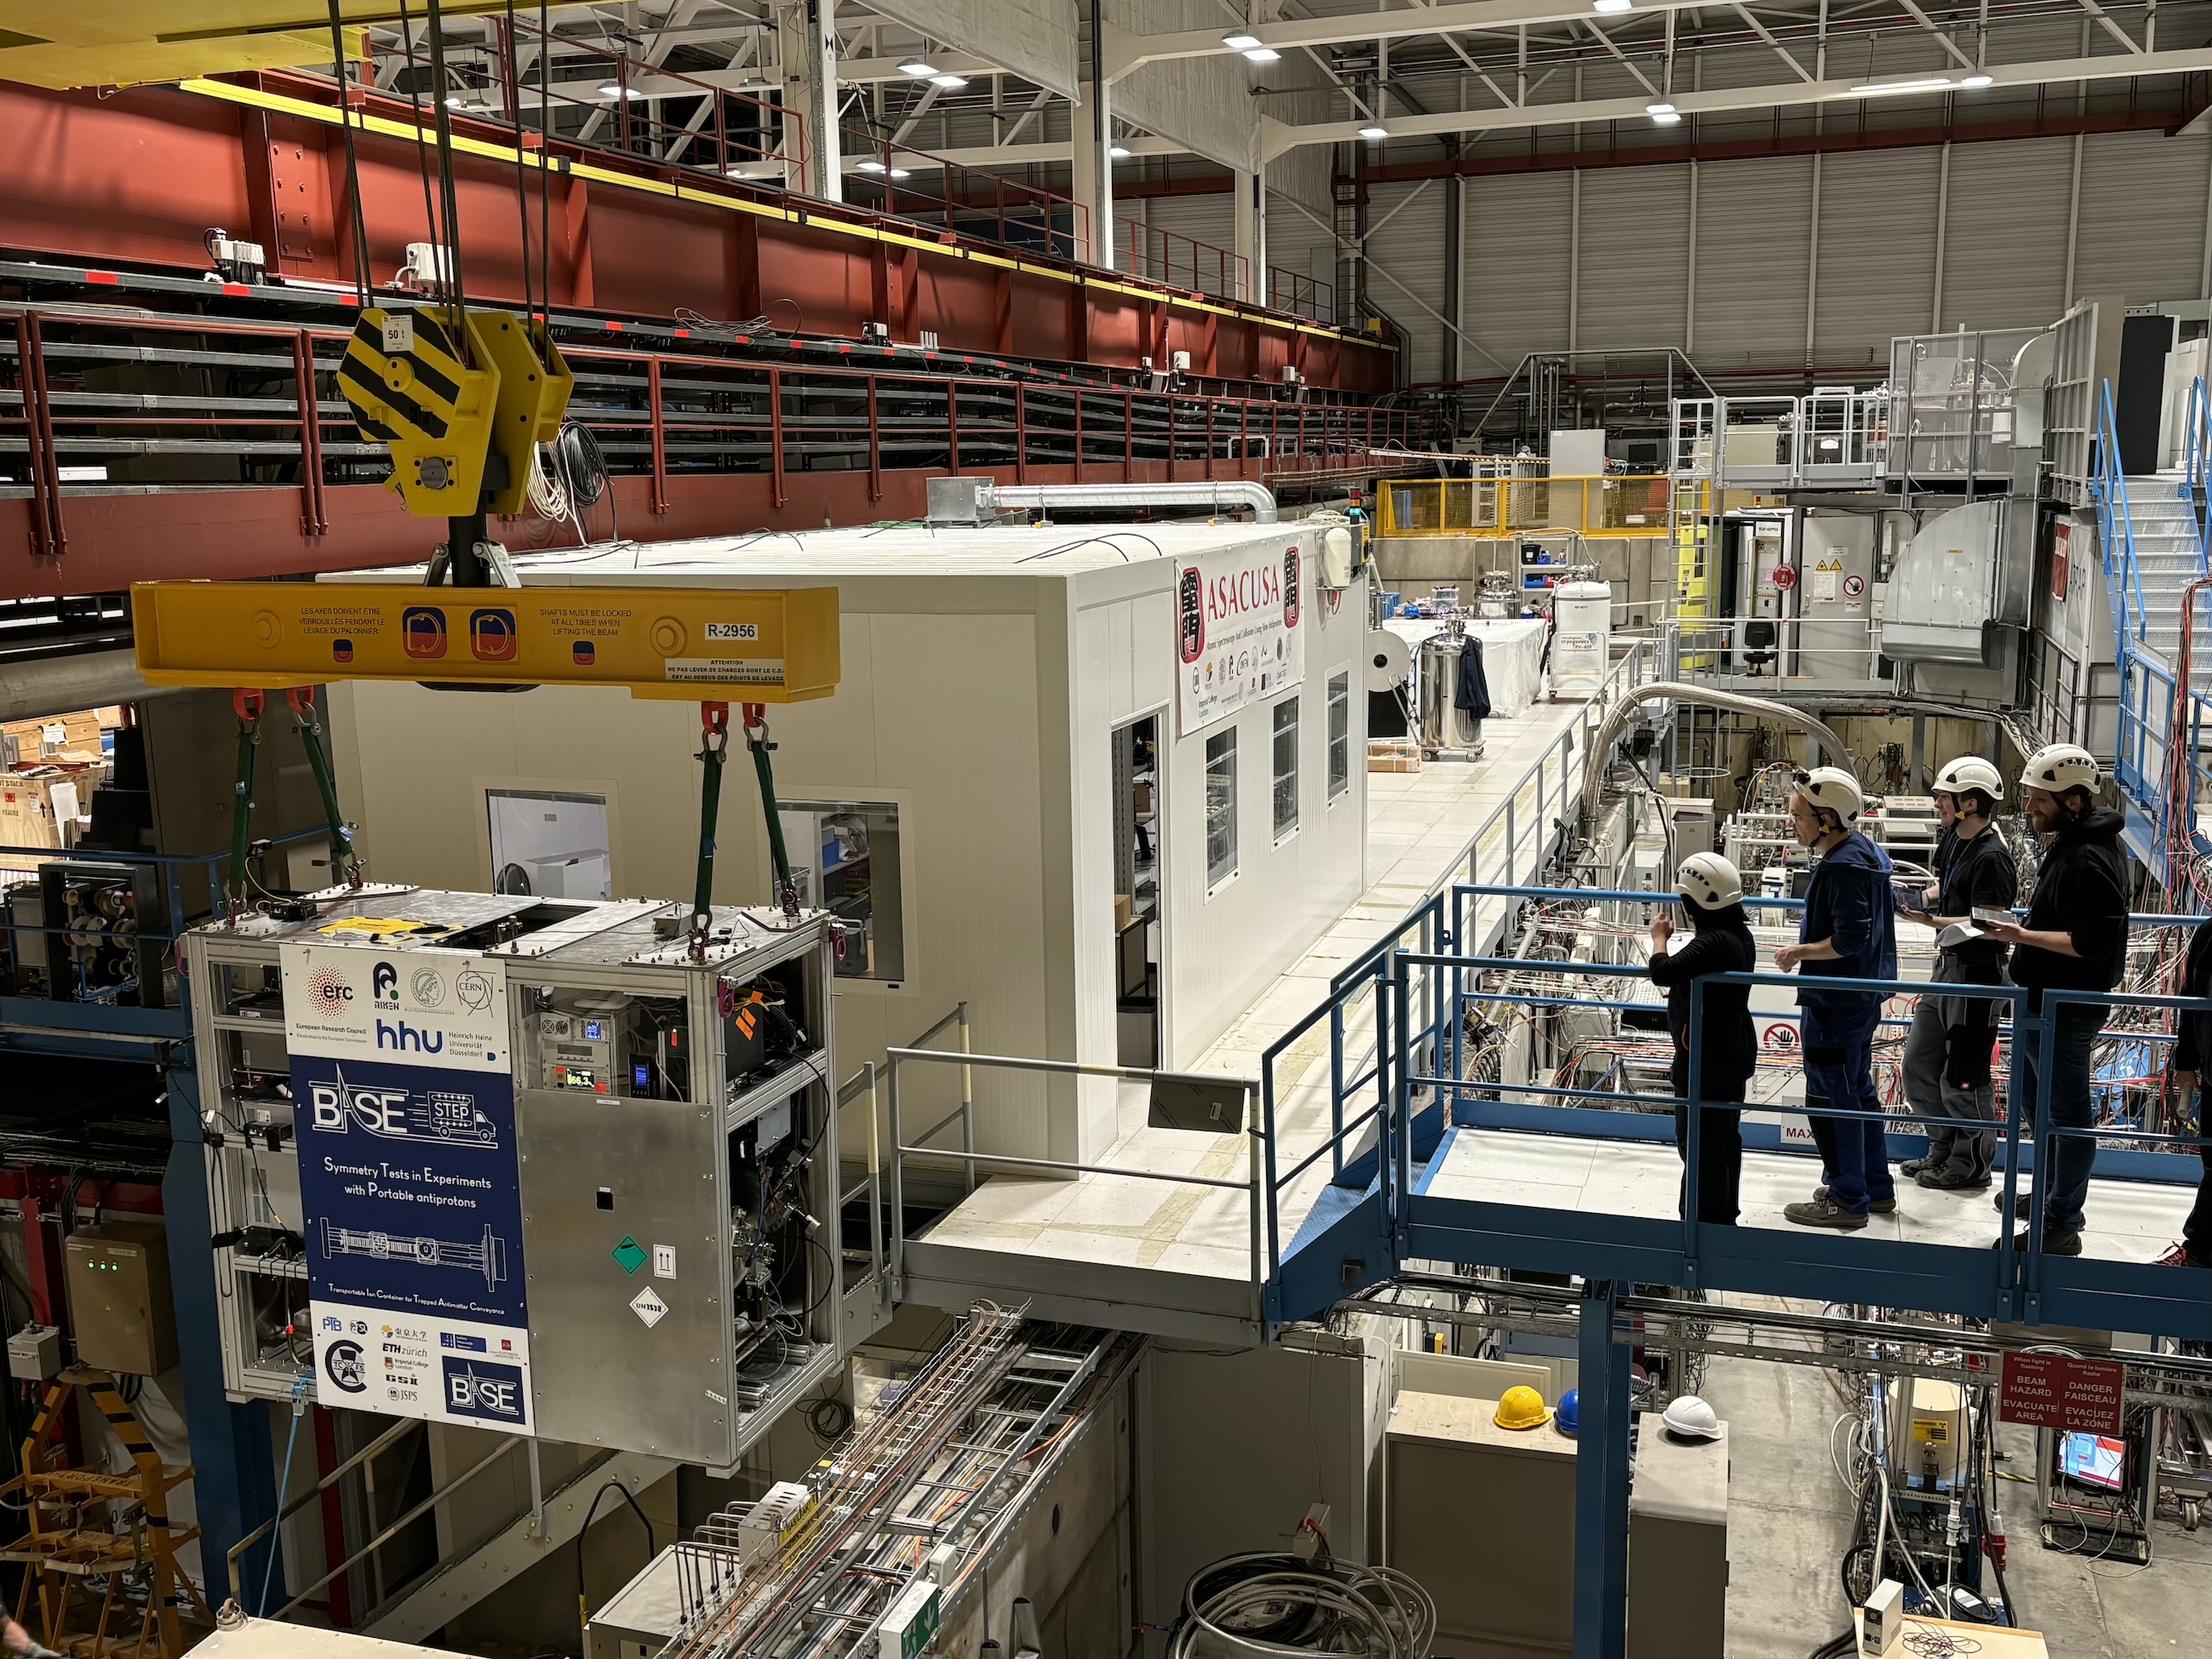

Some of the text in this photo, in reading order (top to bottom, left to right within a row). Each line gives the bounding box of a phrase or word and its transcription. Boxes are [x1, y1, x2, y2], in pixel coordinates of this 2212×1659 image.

[388, 329, 398, 340] 50
[1207, 564, 1280, 622] ASACUSA
[708, 624, 755, 638] R-2956
[1217, 634, 1235, 649] Spectroscopy
[1241, 627, 1254, 638] Collisions
[324, 985, 353, 1000] erc
[459, 982, 482, 992] CERN
[375, 1001, 399, 1010] RIKEN
[376, 1019, 443, 1054] hhu
[449, 1032, 473, 1040] Heinrich
[450, 1040, 482, 1049] Universität
[450, 1049, 483, 1058] Düsseldorf
[310, 1077, 410, 1135] BASE
[324, 1157, 492, 1189] Symmetry Tests in Experiments
[345, 1181, 477, 1209] with Portable antiprotons
[329, 1283, 365, 1297] Transportable
[366, 1288, 375, 1297] Ion
[376, 1290, 404, 1301] Container
[413, 1294, 437, 1307] Trapped
[438, 1298, 468, 1310] Antimatter
[470, 1302, 505, 1315] Conveyance
[323, 1317, 342, 1332] PTB
[382, 1342, 427, 1358] ETH zürich
[413, 1360, 428, 1369] College
[2020, 1364, 2044, 1372] flashing
[2031, 1358, 2045, 1366] light
[2016, 1376, 2047, 1386] BEAM
[450, 1370, 517, 1411] BASE
[2010, 1385, 2052, 1398] HAZARD
[2069, 1382, 2113, 1394] DANGER
[400, 1389, 418, 1402] JSPS
[2065, 1392, 2117, 1404] FAISCEAU
[2003, 1399, 2058, 1413] EVACUATE
[2015, 1411, 2043, 1422] AREA
[2066, 1406, 2114, 1420] EVACUEZ
[2066, 1417, 2112, 1430] LA ZONE
[787, 1519, 797, 1533] GAS
